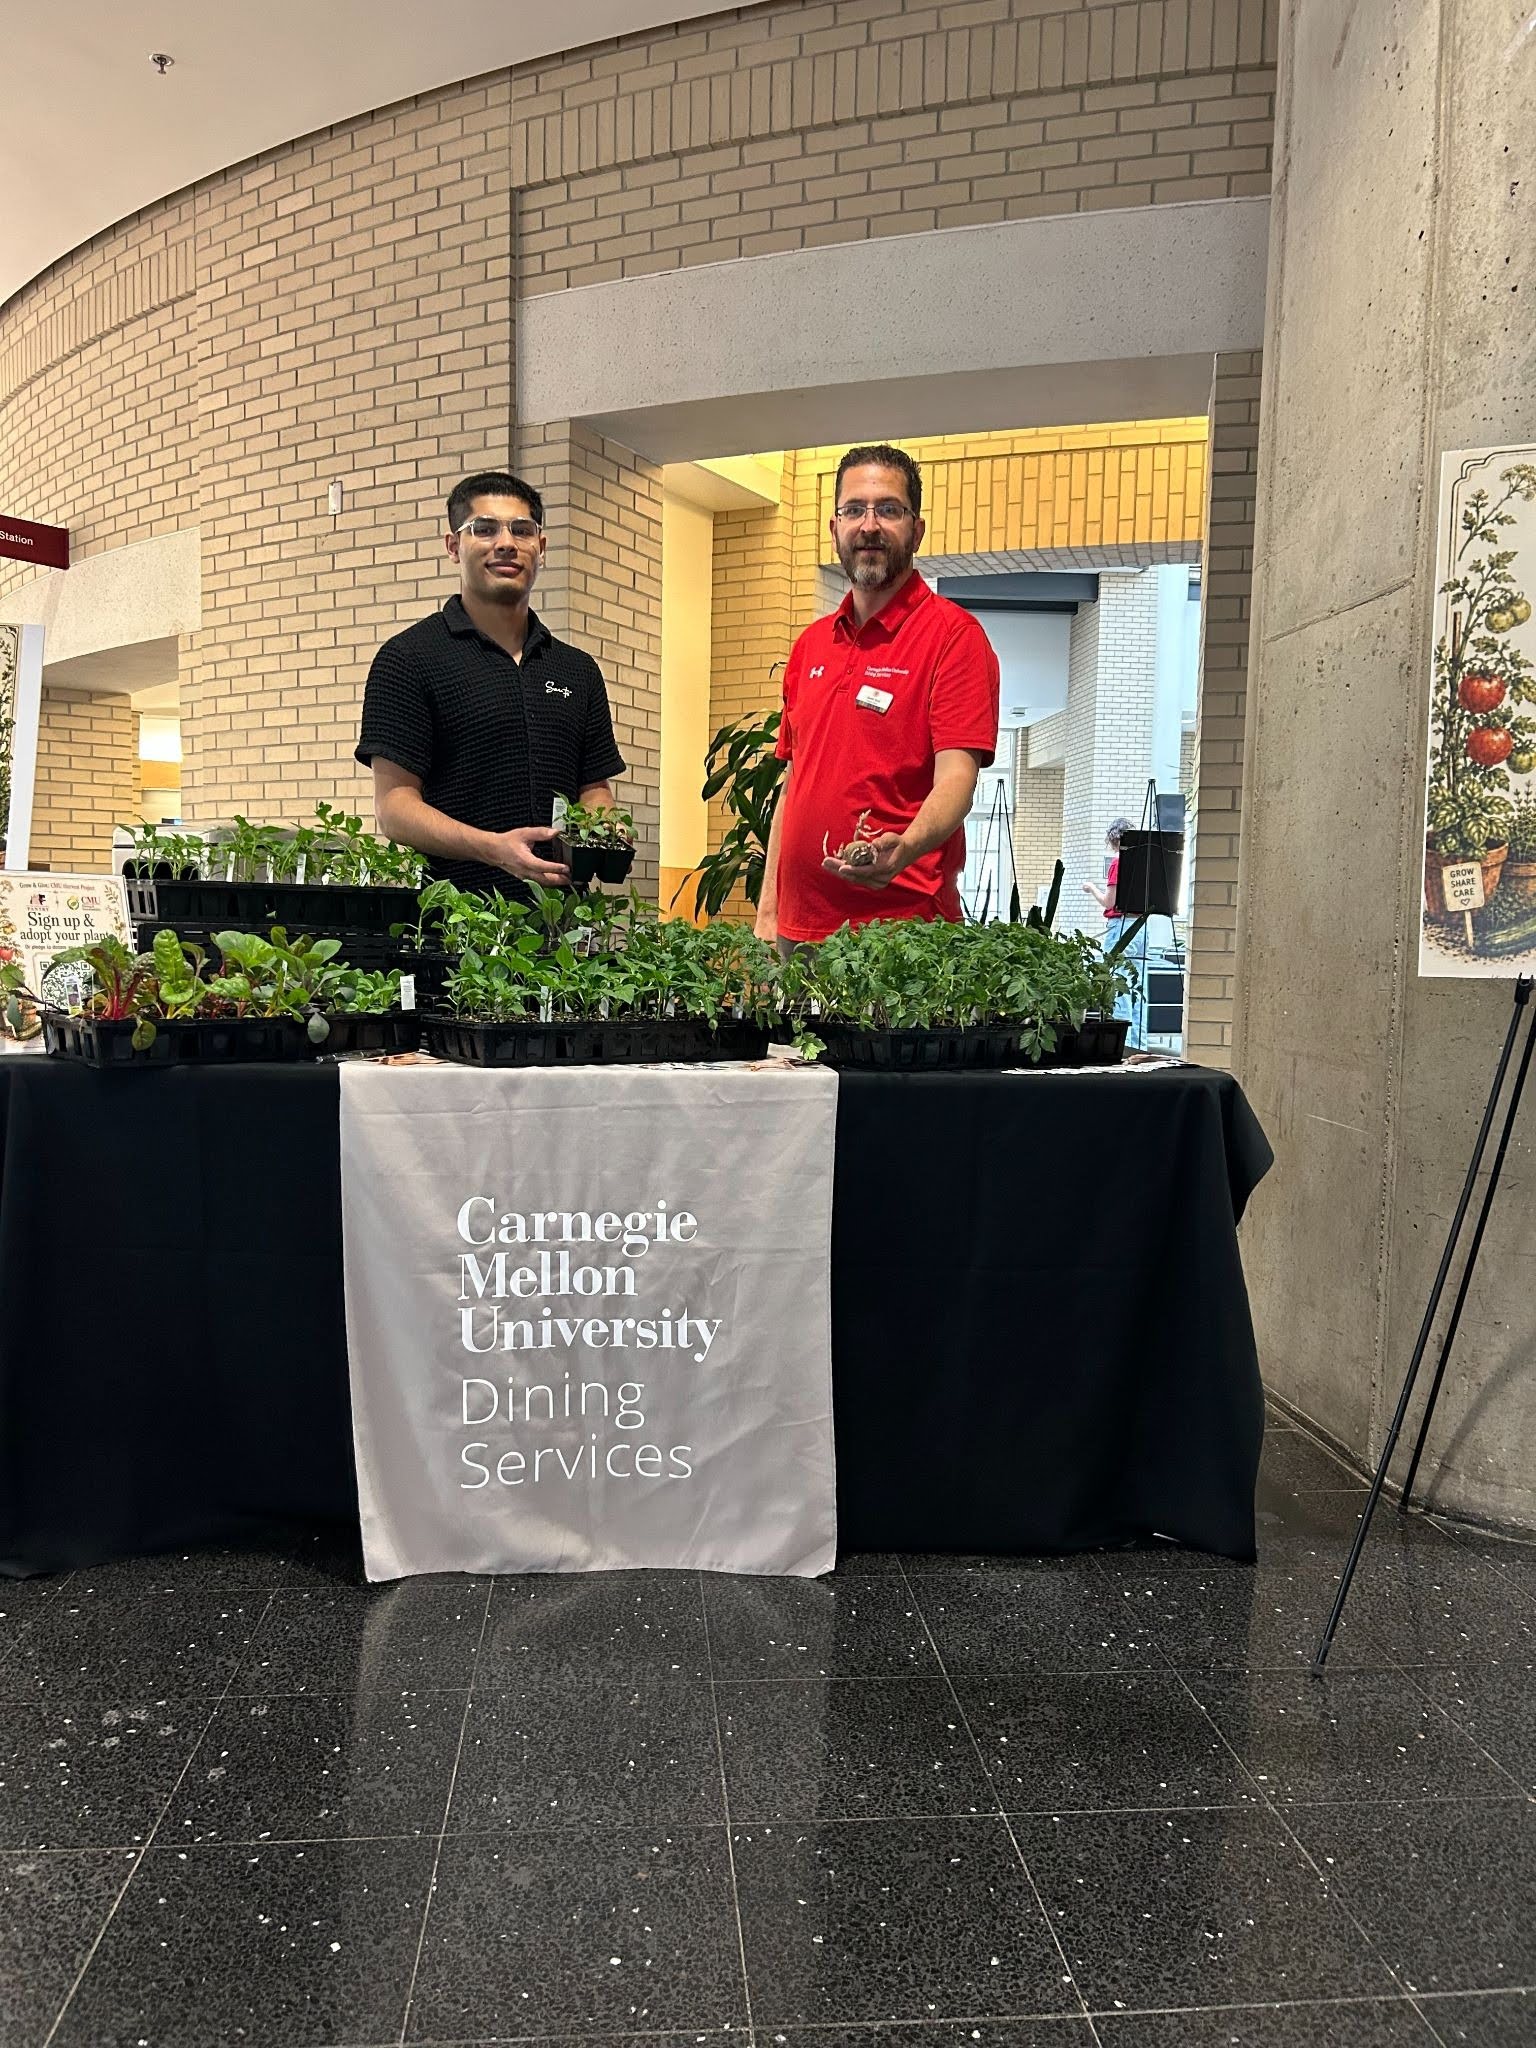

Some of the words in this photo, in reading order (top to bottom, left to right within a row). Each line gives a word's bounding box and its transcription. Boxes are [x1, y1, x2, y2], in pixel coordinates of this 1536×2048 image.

[0, 530, 34, 546] Station
[1450, 868, 1474, 878] GROW
[1451, 878, 1476, 888] SHARE
[81, 896, 101, 904] CMU
[1453, 888, 1475, 897] CARE
[28, 911, 60, 931] Sign
[63, 917, 80, 931] up
[83, 913, 95, 927] &
[20, 928, 51, 943] adopt
[55, 932, 80, 943] your
[457, 1196, 698, 1258] Carnegie
[457, 1250, 639, 1301] Mellon
[457, 1305, 723, 1363] University
[462, 1371, 645, 1430] Dining
[460, 1432, 693, 1489] Services
